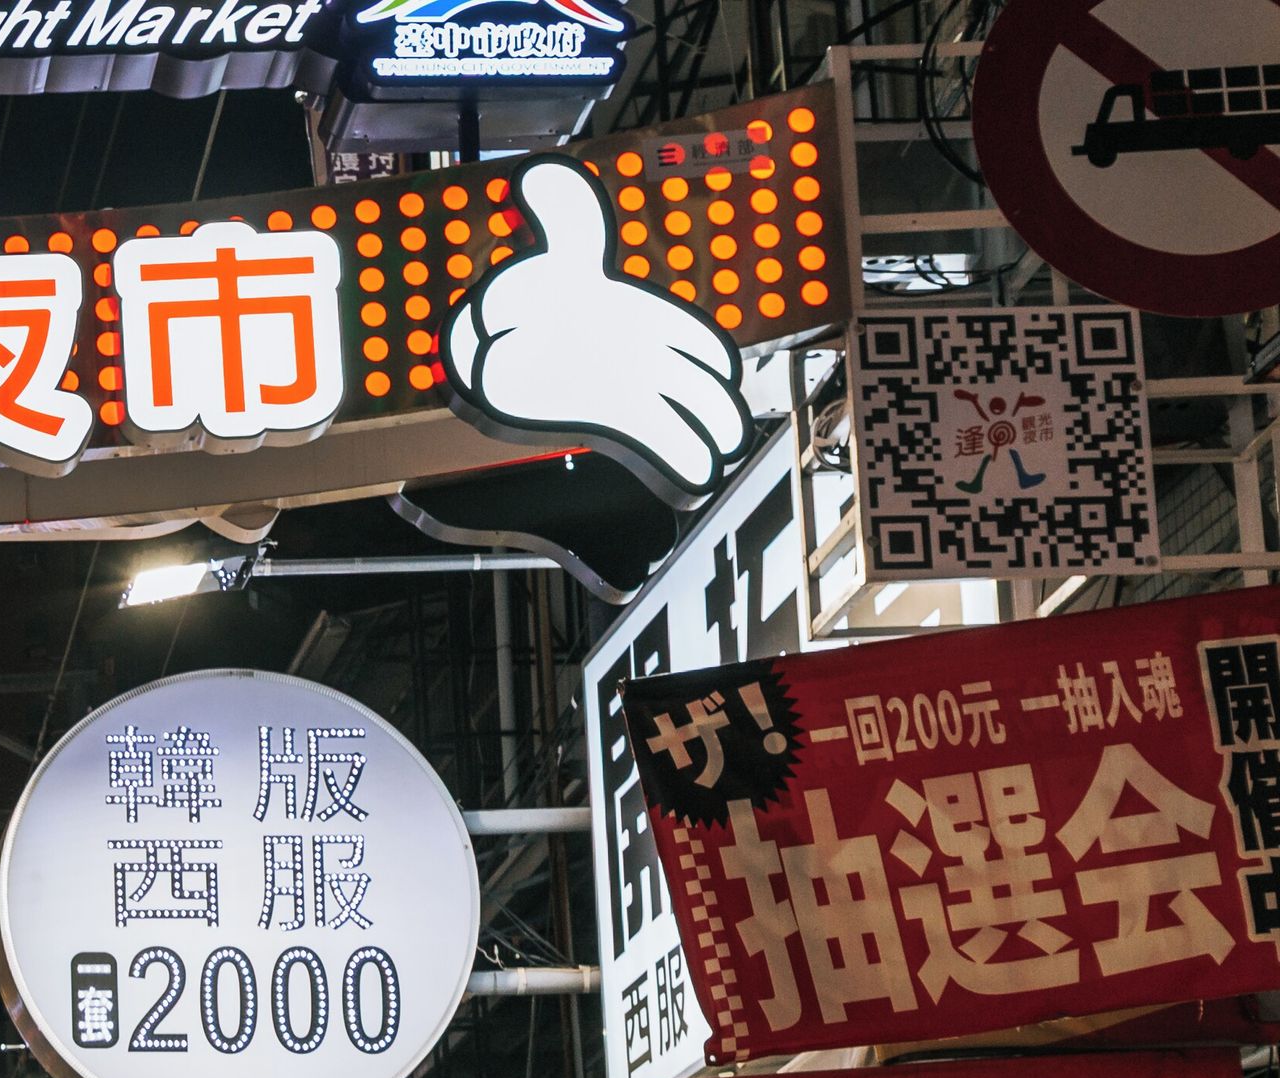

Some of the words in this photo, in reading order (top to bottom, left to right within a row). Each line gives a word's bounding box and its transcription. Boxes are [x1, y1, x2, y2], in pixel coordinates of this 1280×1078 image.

[66, 0, 323, 47] Market
[954, 425, 985, 458] 逢
[808, 679, 1006, 768] 一回200元
[1020, 650, 1184, 736] 一抽入魂
[104, 724, 370, 824] 韓版
[107, 834, 374, 931] 西服
[718, 742, 1237, 1033] 抽選会
[127, 945, 401, 1055] 2000
